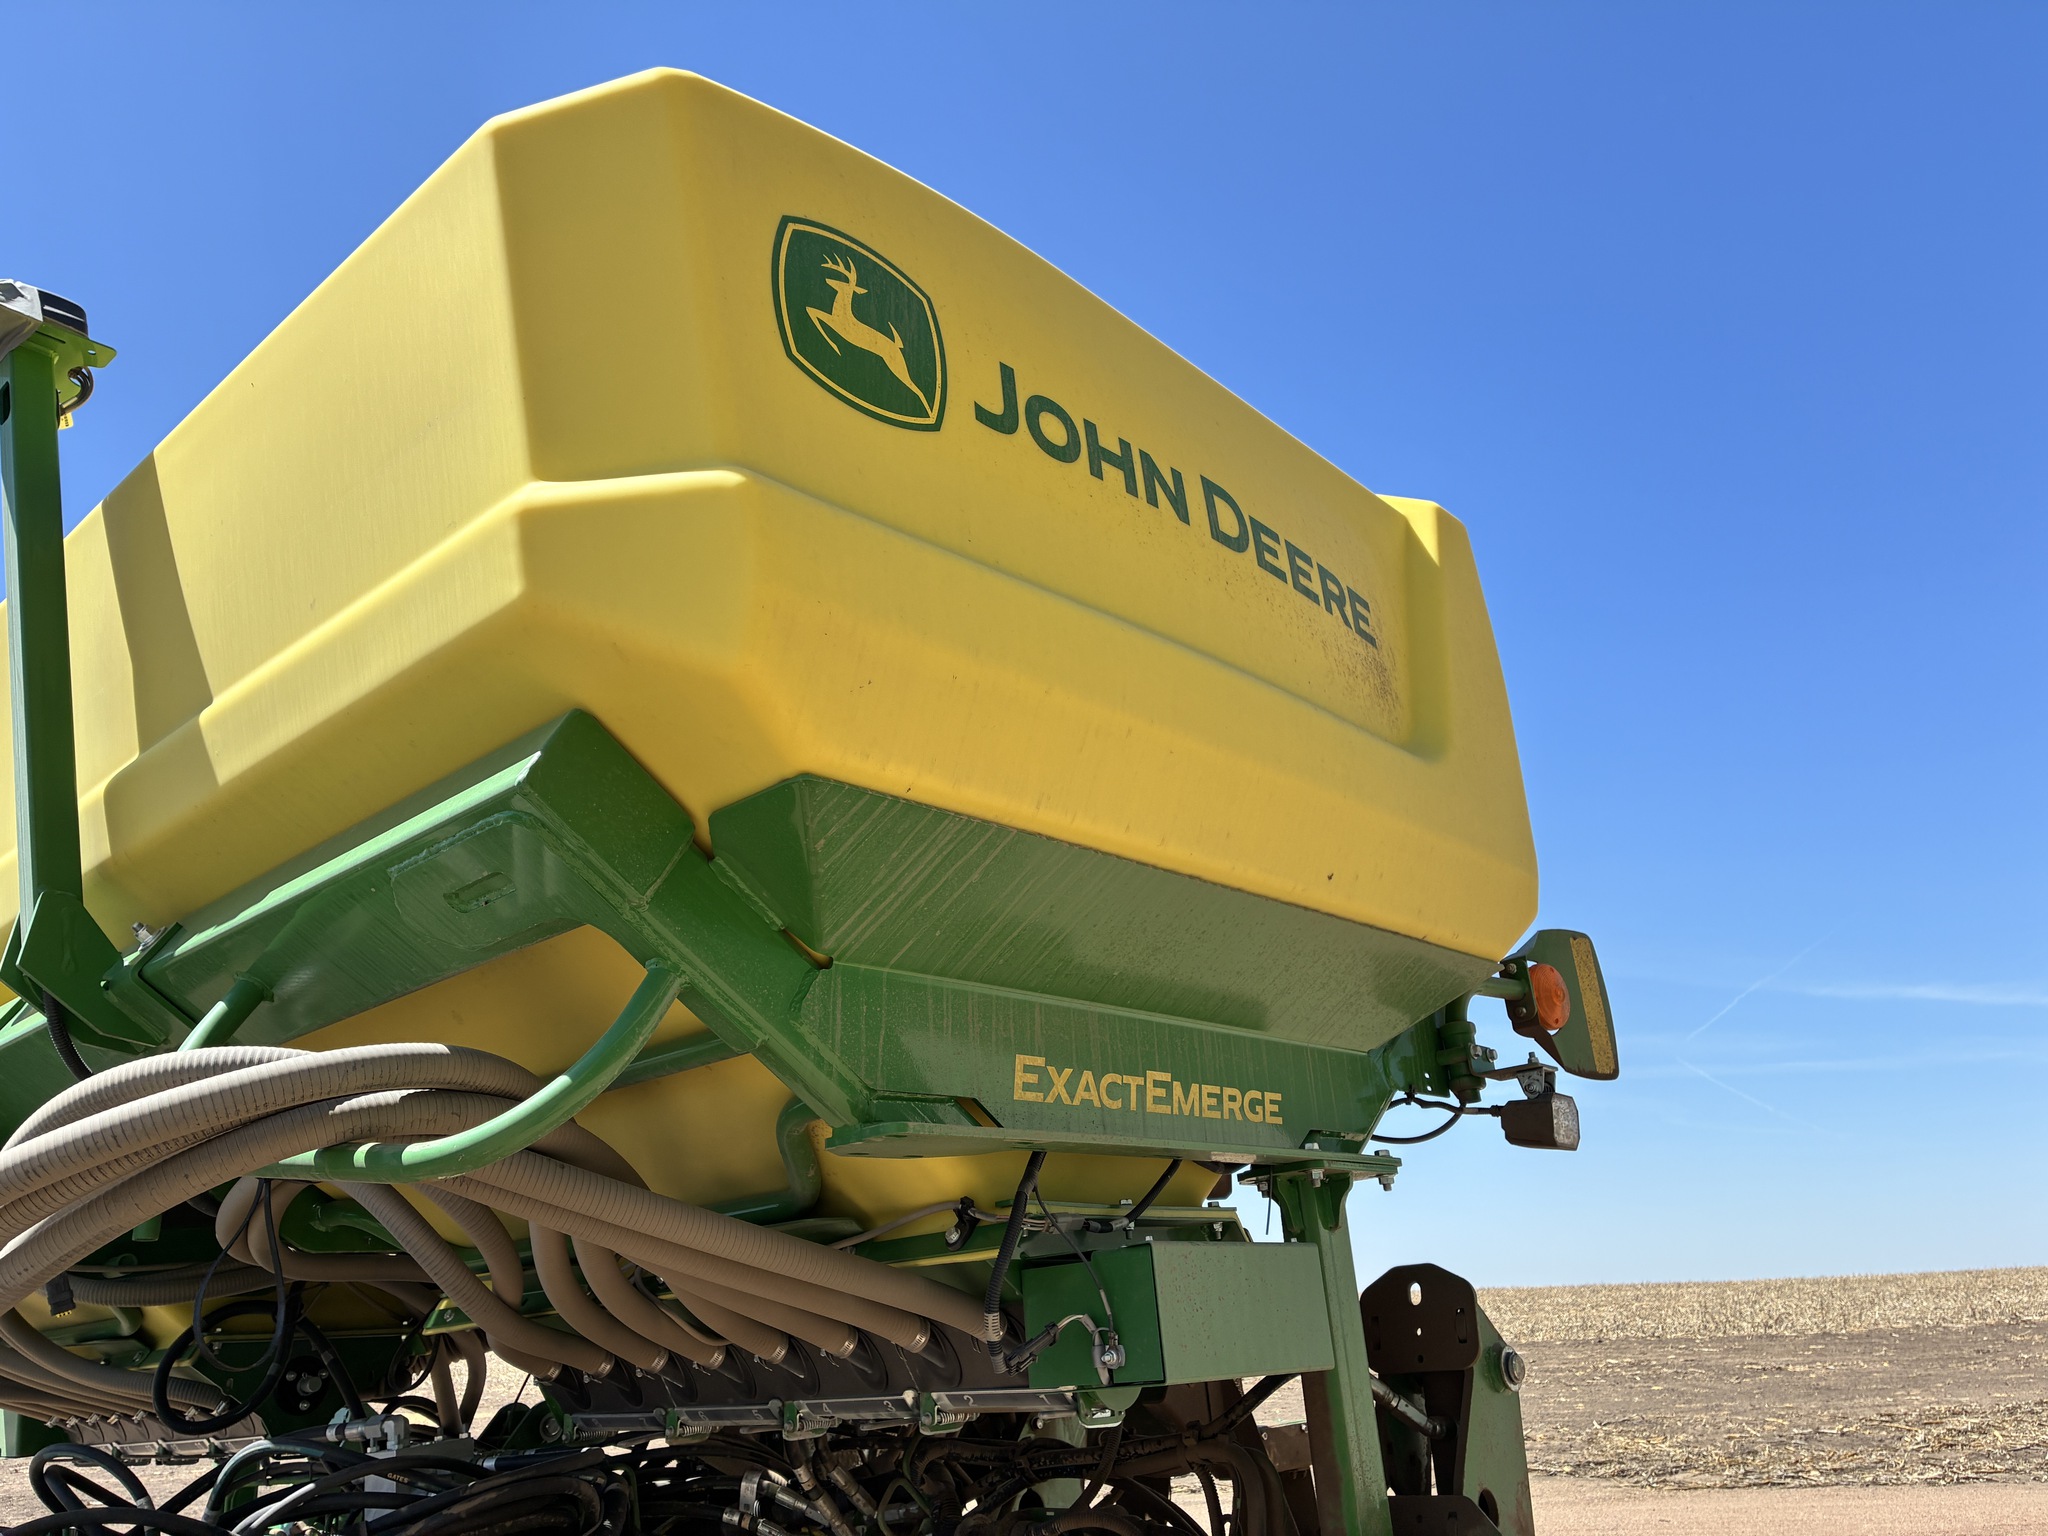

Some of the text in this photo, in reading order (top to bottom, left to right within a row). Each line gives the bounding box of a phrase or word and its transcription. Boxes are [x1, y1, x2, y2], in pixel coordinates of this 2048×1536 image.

[974, 361, 1378, 649] JOHN DEERE
[1013, 1053, 1283, 1125] EXACTEMERGE
[822, 1400, 896, 1414] 4 3
[963, 1394, 1051, 1407] 2 1
[698, 1409, 764, 1421] 6 5
[386, 1472, 409, 1484] GATES
